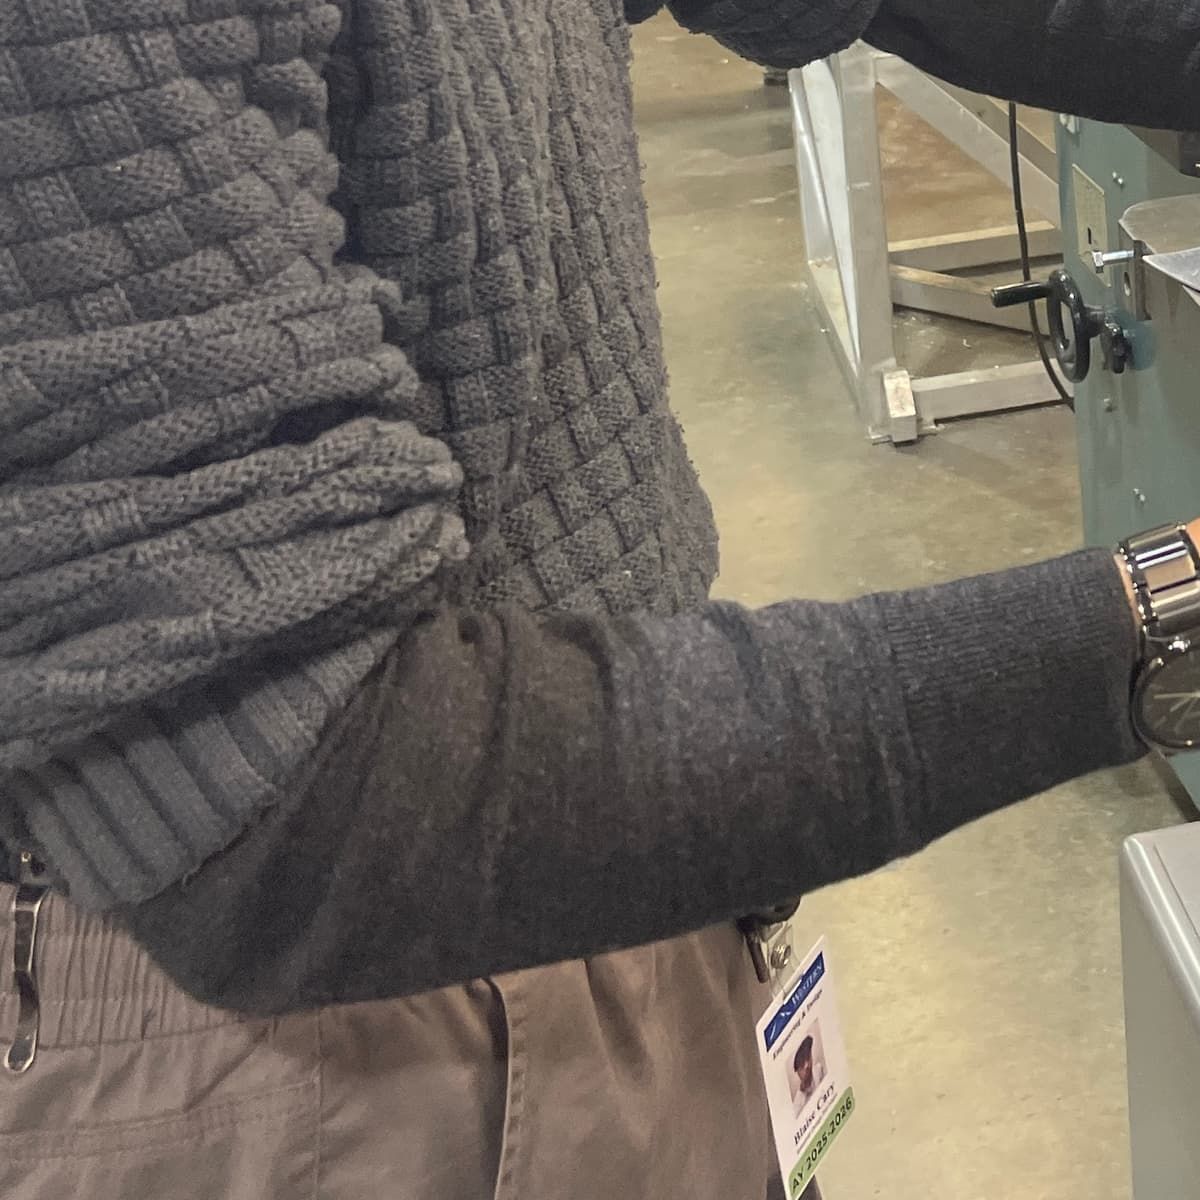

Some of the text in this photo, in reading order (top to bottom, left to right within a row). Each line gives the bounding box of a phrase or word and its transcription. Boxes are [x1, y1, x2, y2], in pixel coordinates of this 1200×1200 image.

[793, 1166, 804, 1194] AY
[805, 1096, 852, 1171] 2025-2026
[794, 1110, 816, 1145] Blaise
[816, 1080, 834, 1110] Cary
